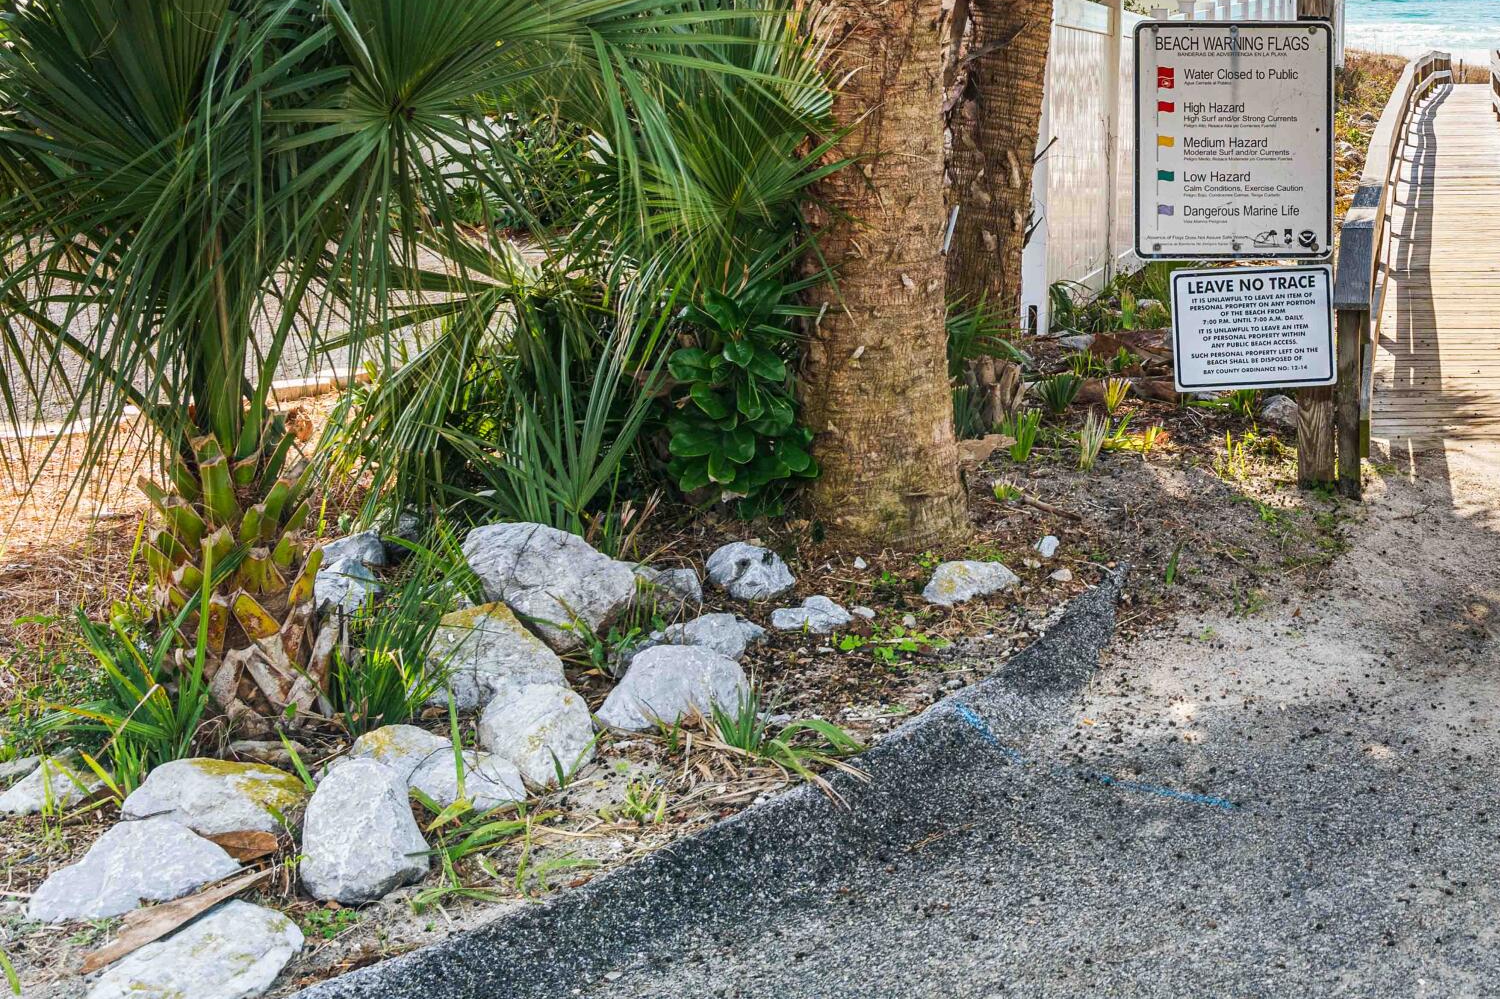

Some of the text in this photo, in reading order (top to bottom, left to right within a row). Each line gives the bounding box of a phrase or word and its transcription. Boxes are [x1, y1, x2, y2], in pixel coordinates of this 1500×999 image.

[1155, 37, 1309, 50] BEACH WARNING FLAGS
[1184, 69, 1298, 79] Water Closed to Public
[1184, 102, 1245, 115] High Hazard
[1242, 115, 1265, 123] Strong
[1184, 137, 1268, 147] Medium Hazard
[1184, 171, 1251, 182] Low Hazard
[1184, 205, 1299, 219] Dangerous Marine Life
[1188, 276, 1315, 294] LEAVE NO TRACE
